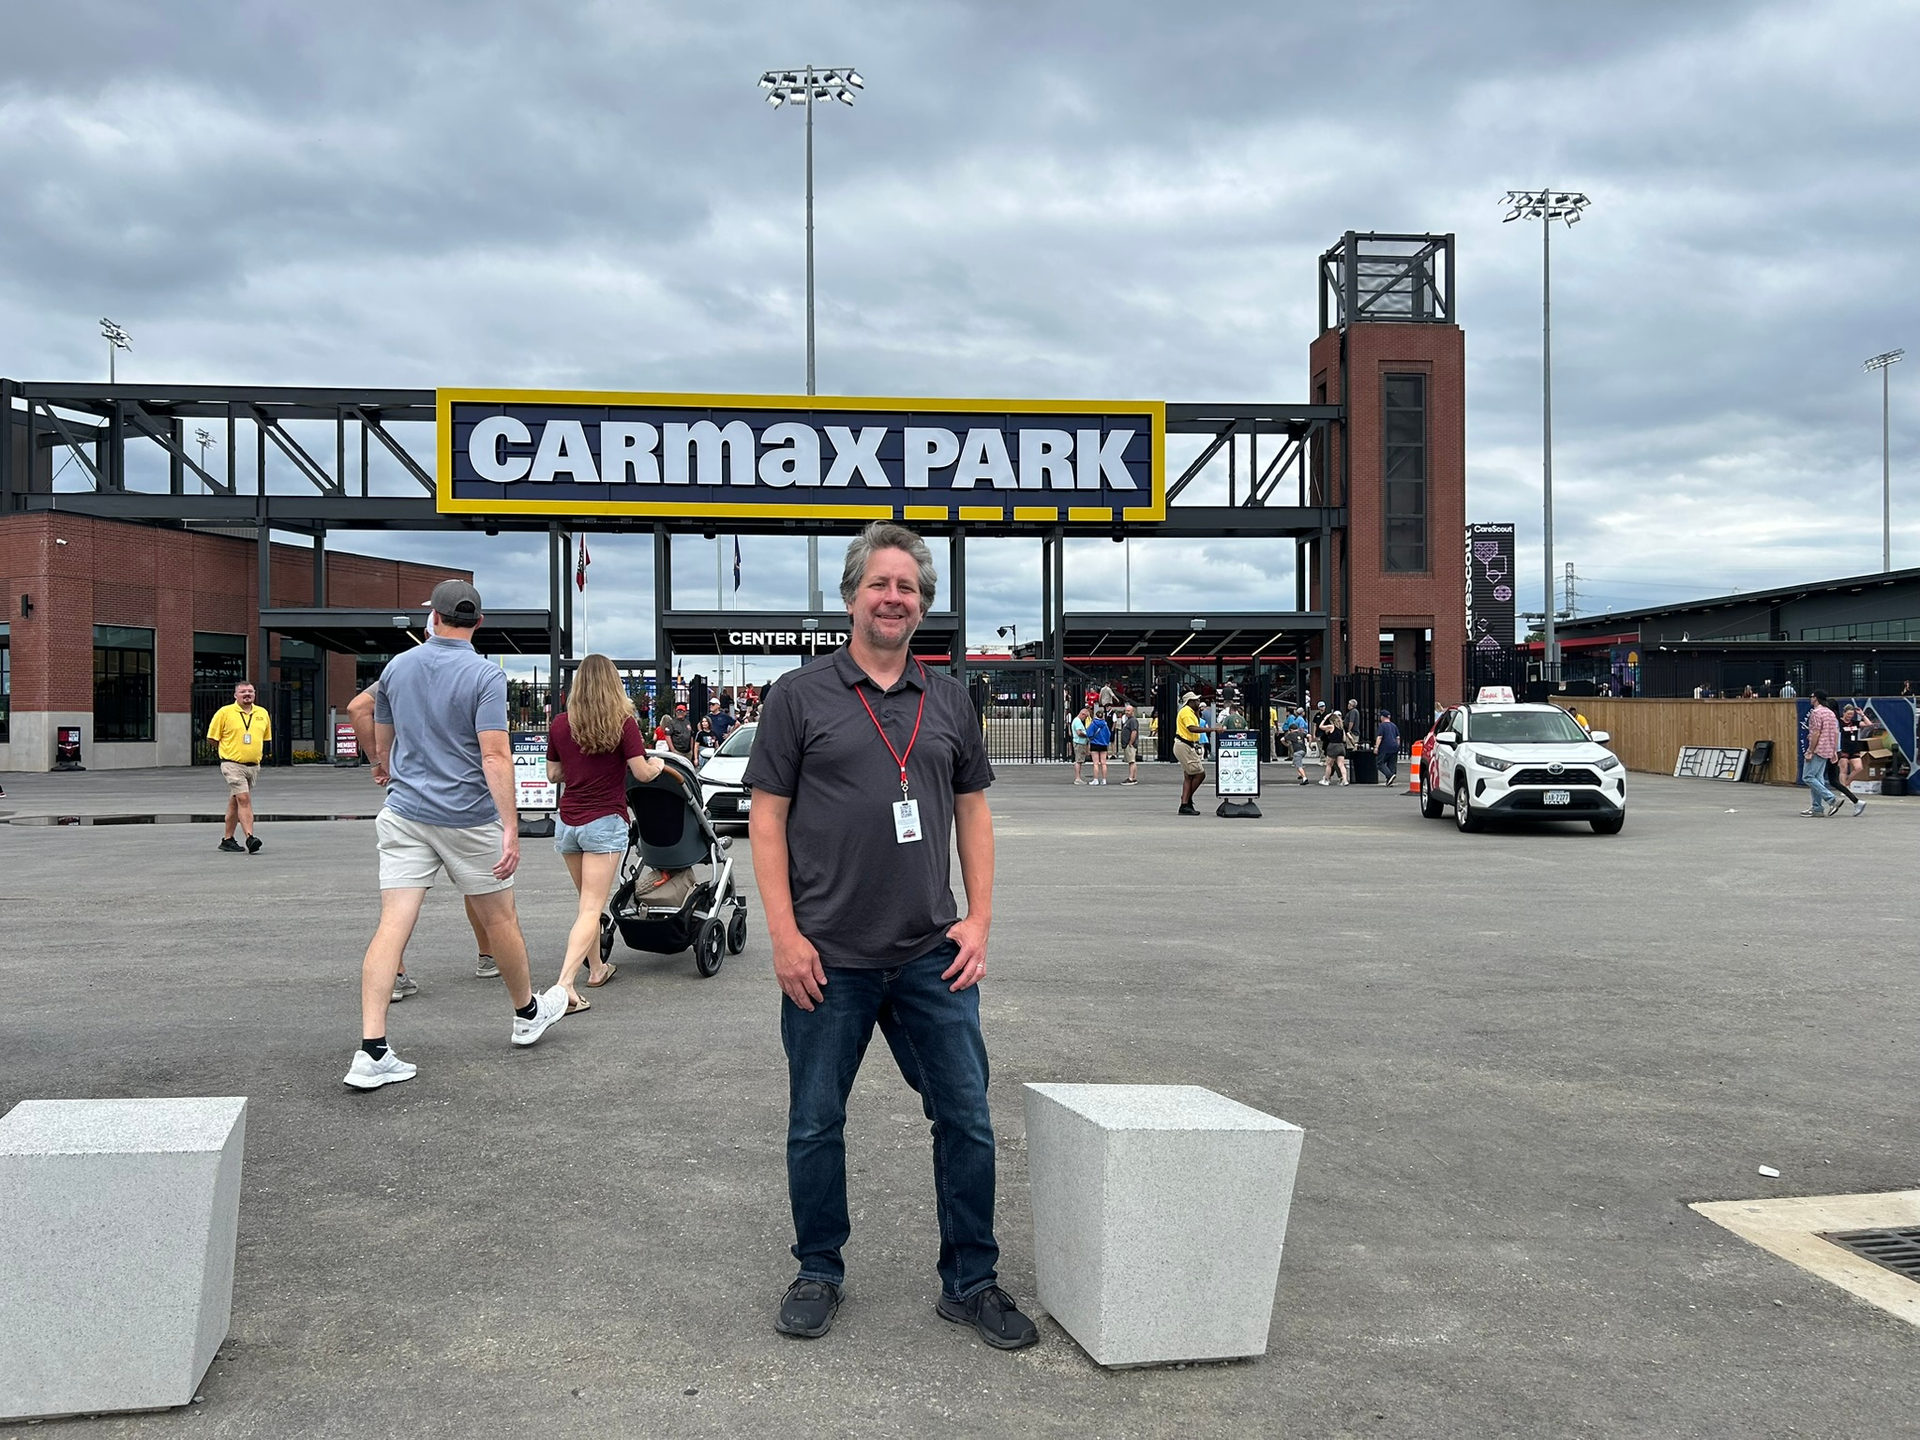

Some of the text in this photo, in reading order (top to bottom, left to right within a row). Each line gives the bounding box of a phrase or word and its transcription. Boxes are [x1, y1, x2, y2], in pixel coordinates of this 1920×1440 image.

[902, 425, 1139, 491] PARK
[1474, 525, 1513, 534] CareScout
[728, 631, 849, 646] CENTER FIELD
[515, 744, 530, 752] CLEAR
[530, 744, 540, 752] BAG
